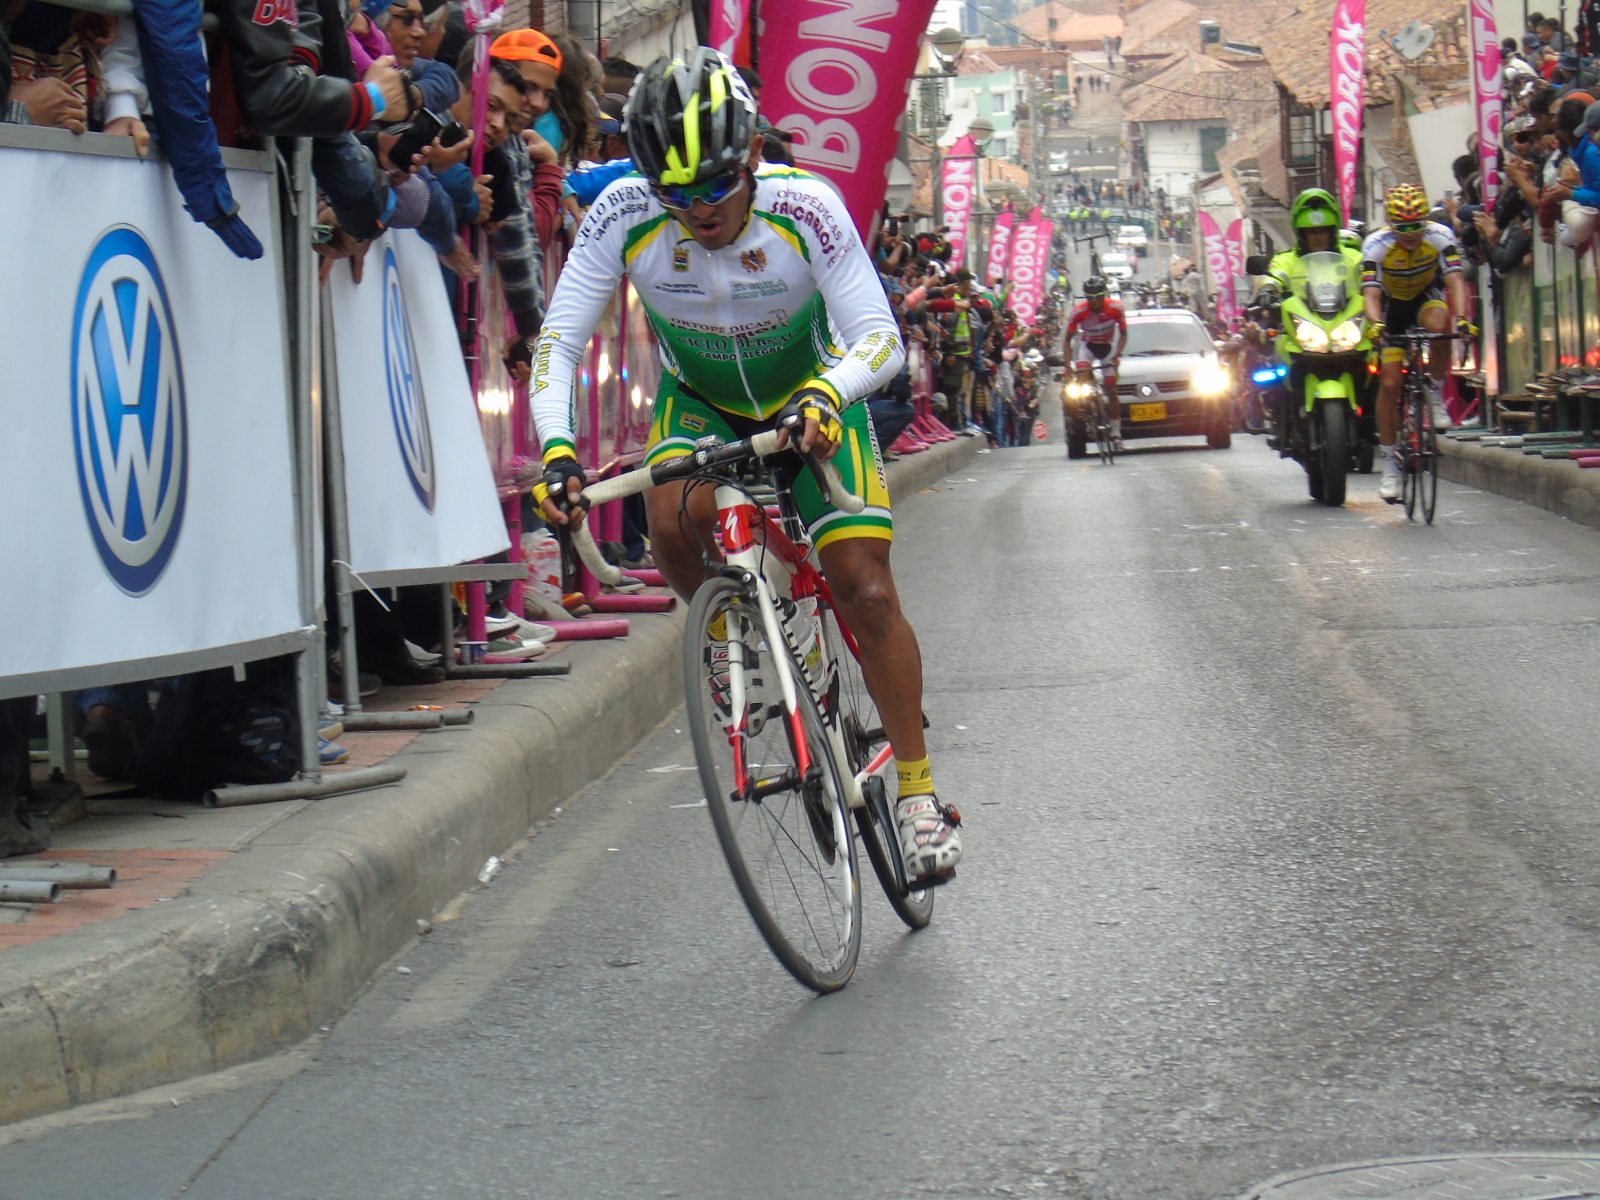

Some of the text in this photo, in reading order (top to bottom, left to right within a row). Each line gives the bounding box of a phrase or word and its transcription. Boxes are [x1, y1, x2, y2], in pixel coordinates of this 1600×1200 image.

[606, 185, 652, 207] BERN
[698, 346, 784, 361] CAMPO ALEGRE
